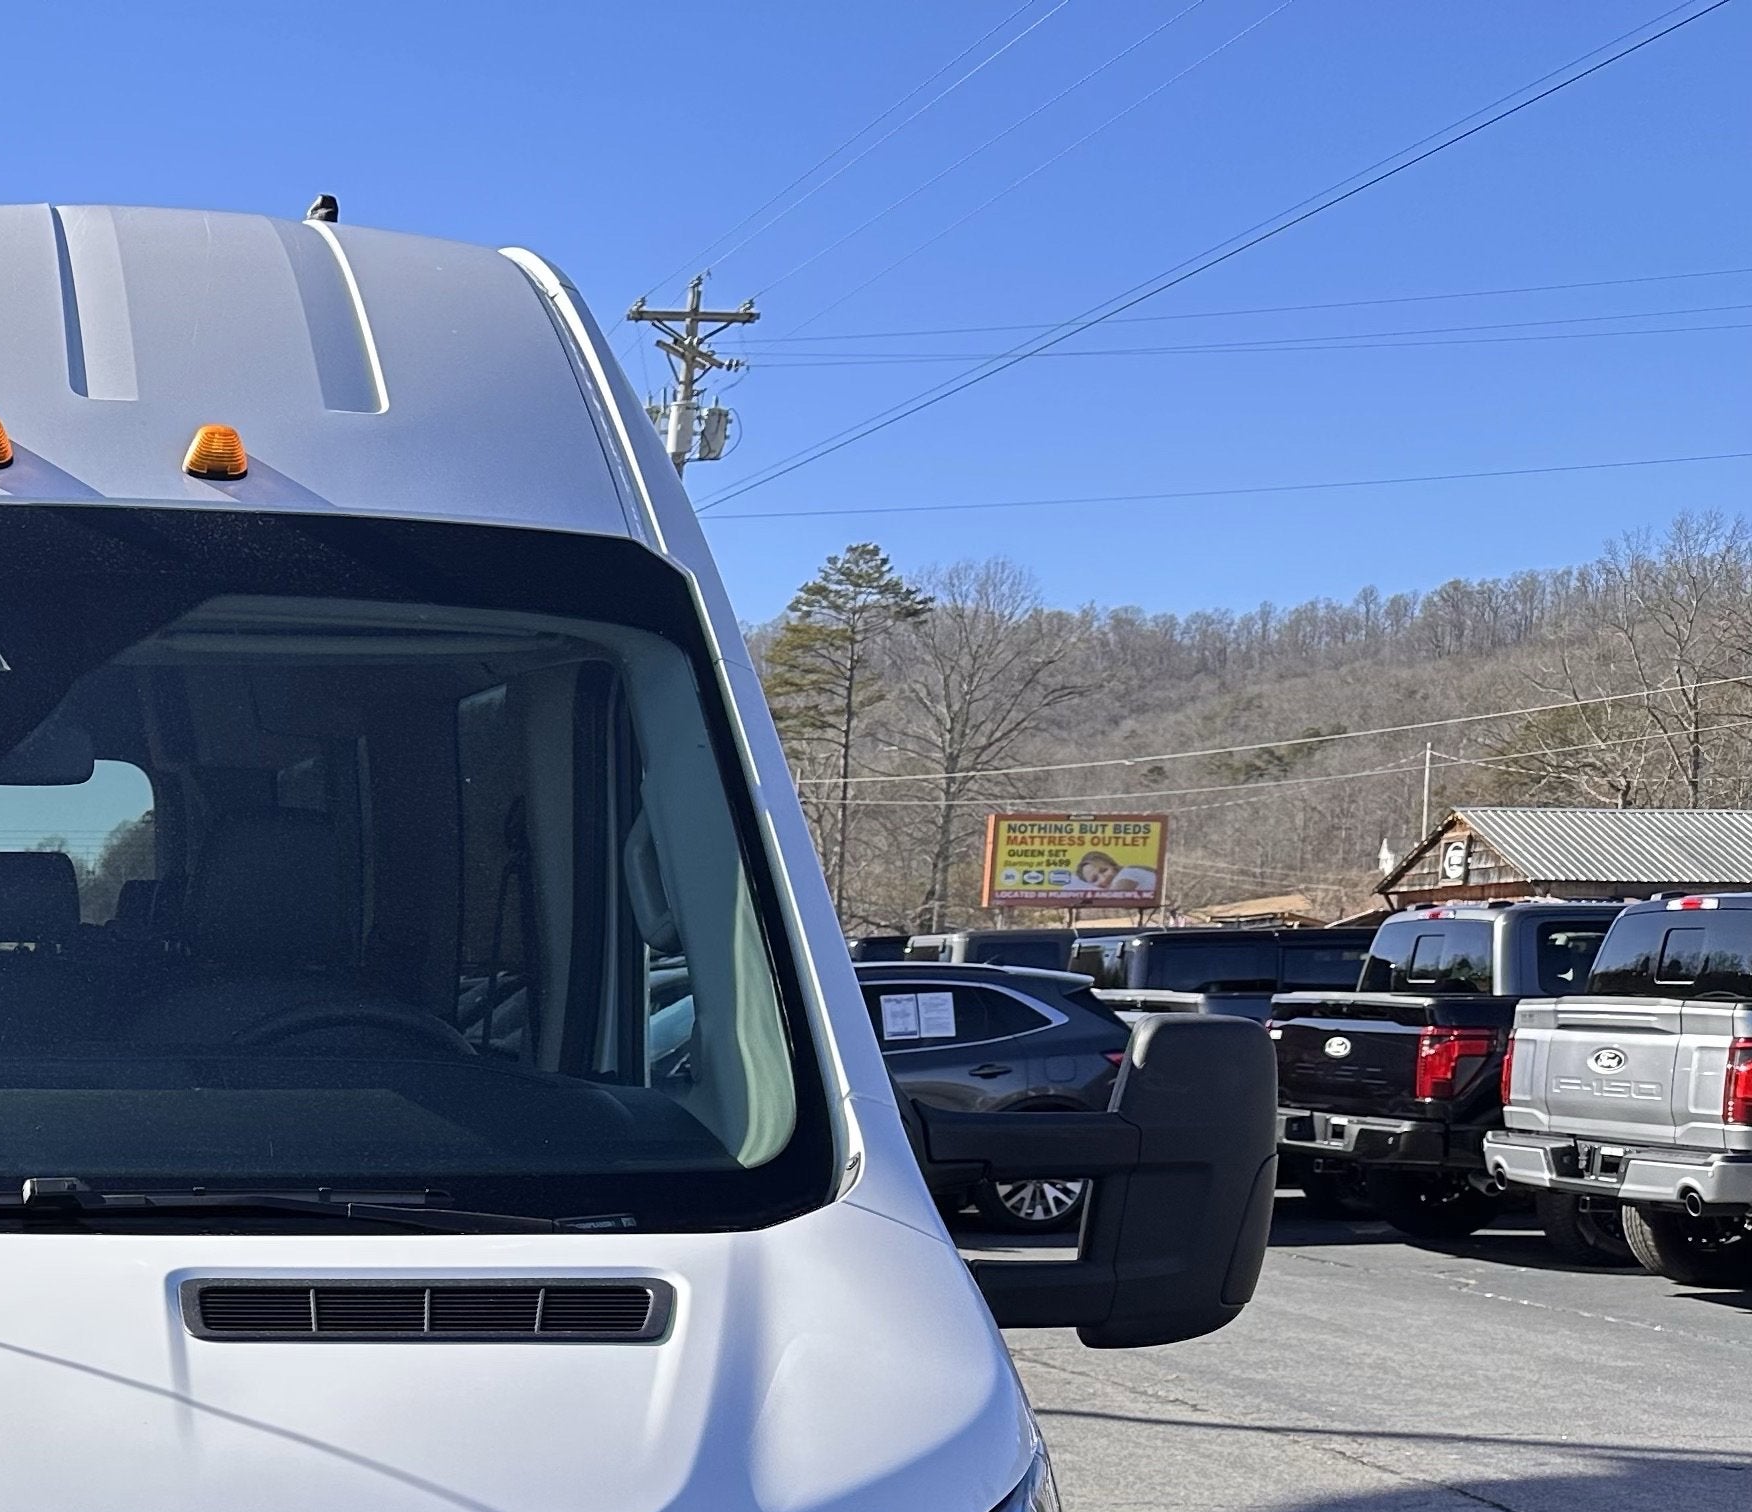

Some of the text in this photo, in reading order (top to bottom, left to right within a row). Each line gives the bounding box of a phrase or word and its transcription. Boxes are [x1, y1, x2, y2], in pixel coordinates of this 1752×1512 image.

[1006, 823, 1151, 835] NOTHING BUT BEDS
[1006, 835, 1150, 847] MATTRESS OUTLET
[1008, 849, 1067, 858] QUEEN SET
[995, 890, 1037, 899] LOCATED
[1552, 1076, 1663, 1101] F-150
